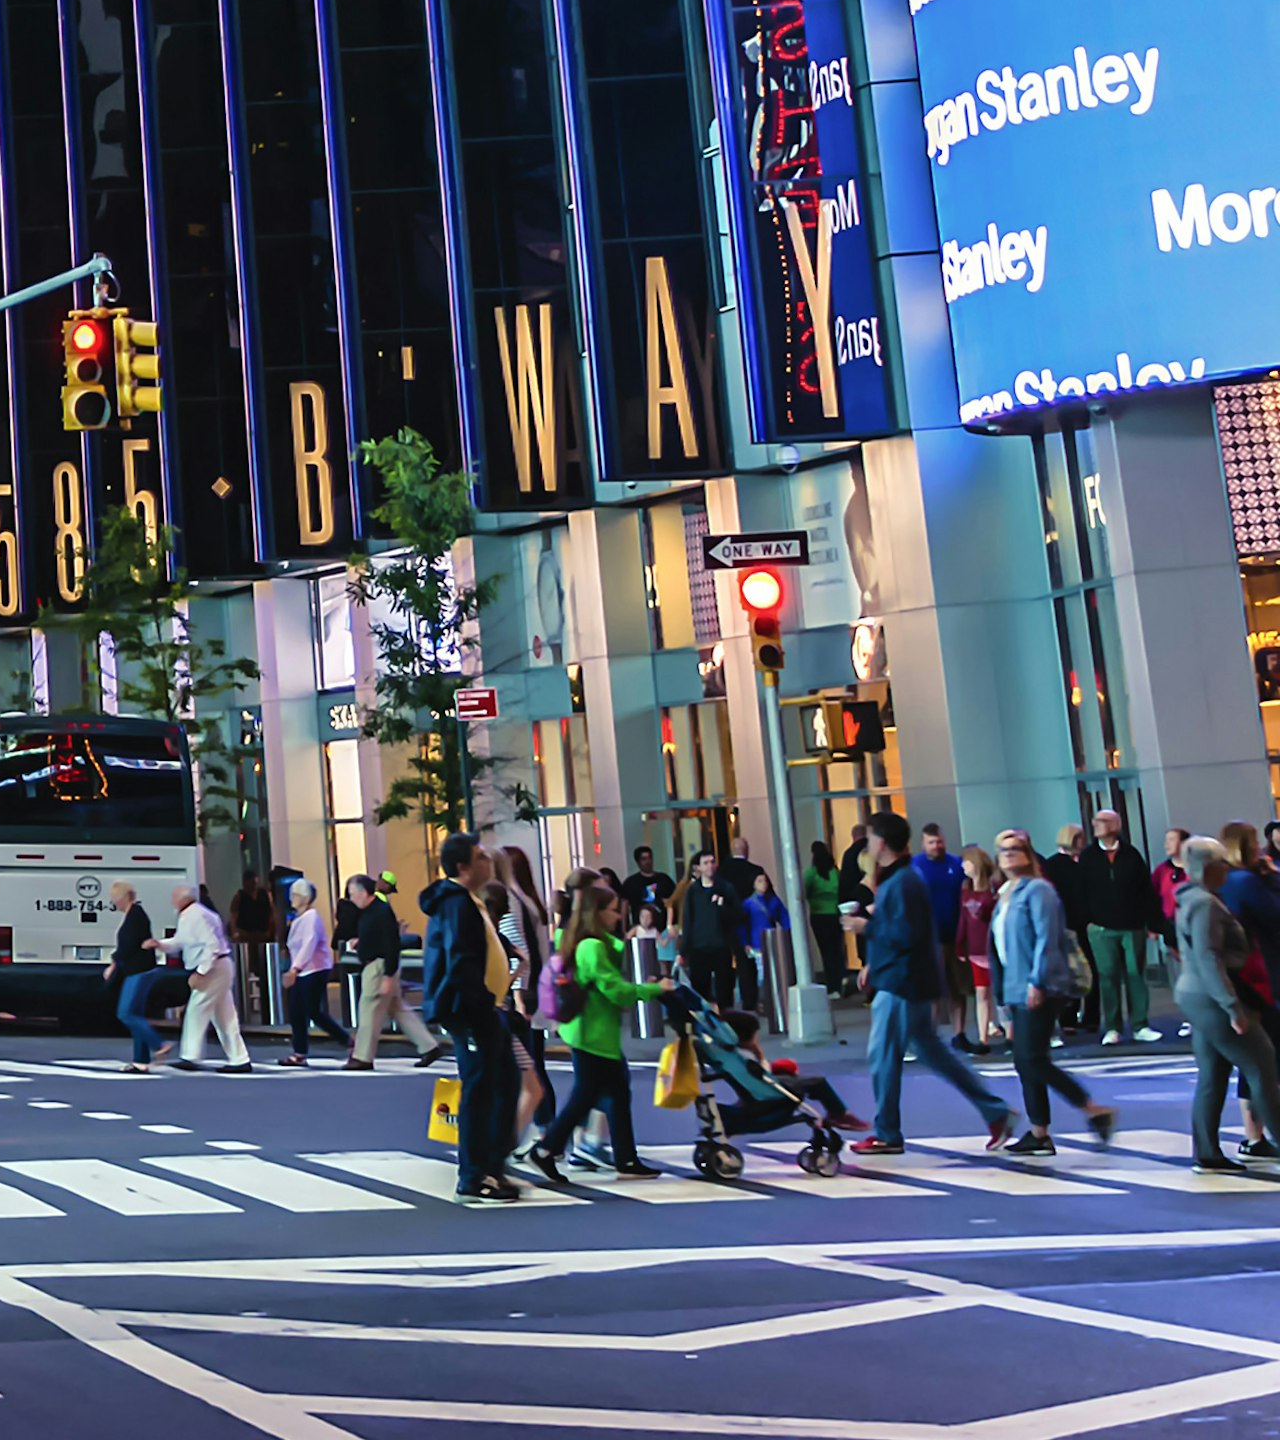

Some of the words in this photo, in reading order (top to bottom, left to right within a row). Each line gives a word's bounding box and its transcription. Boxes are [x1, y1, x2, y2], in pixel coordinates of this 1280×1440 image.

[977, 47, 1159, 130] Stanley
[942, 223, 1047, 303] Stanley
[721, 544, 753, 558] ONE
[760, 542, 793, 556] WAY
